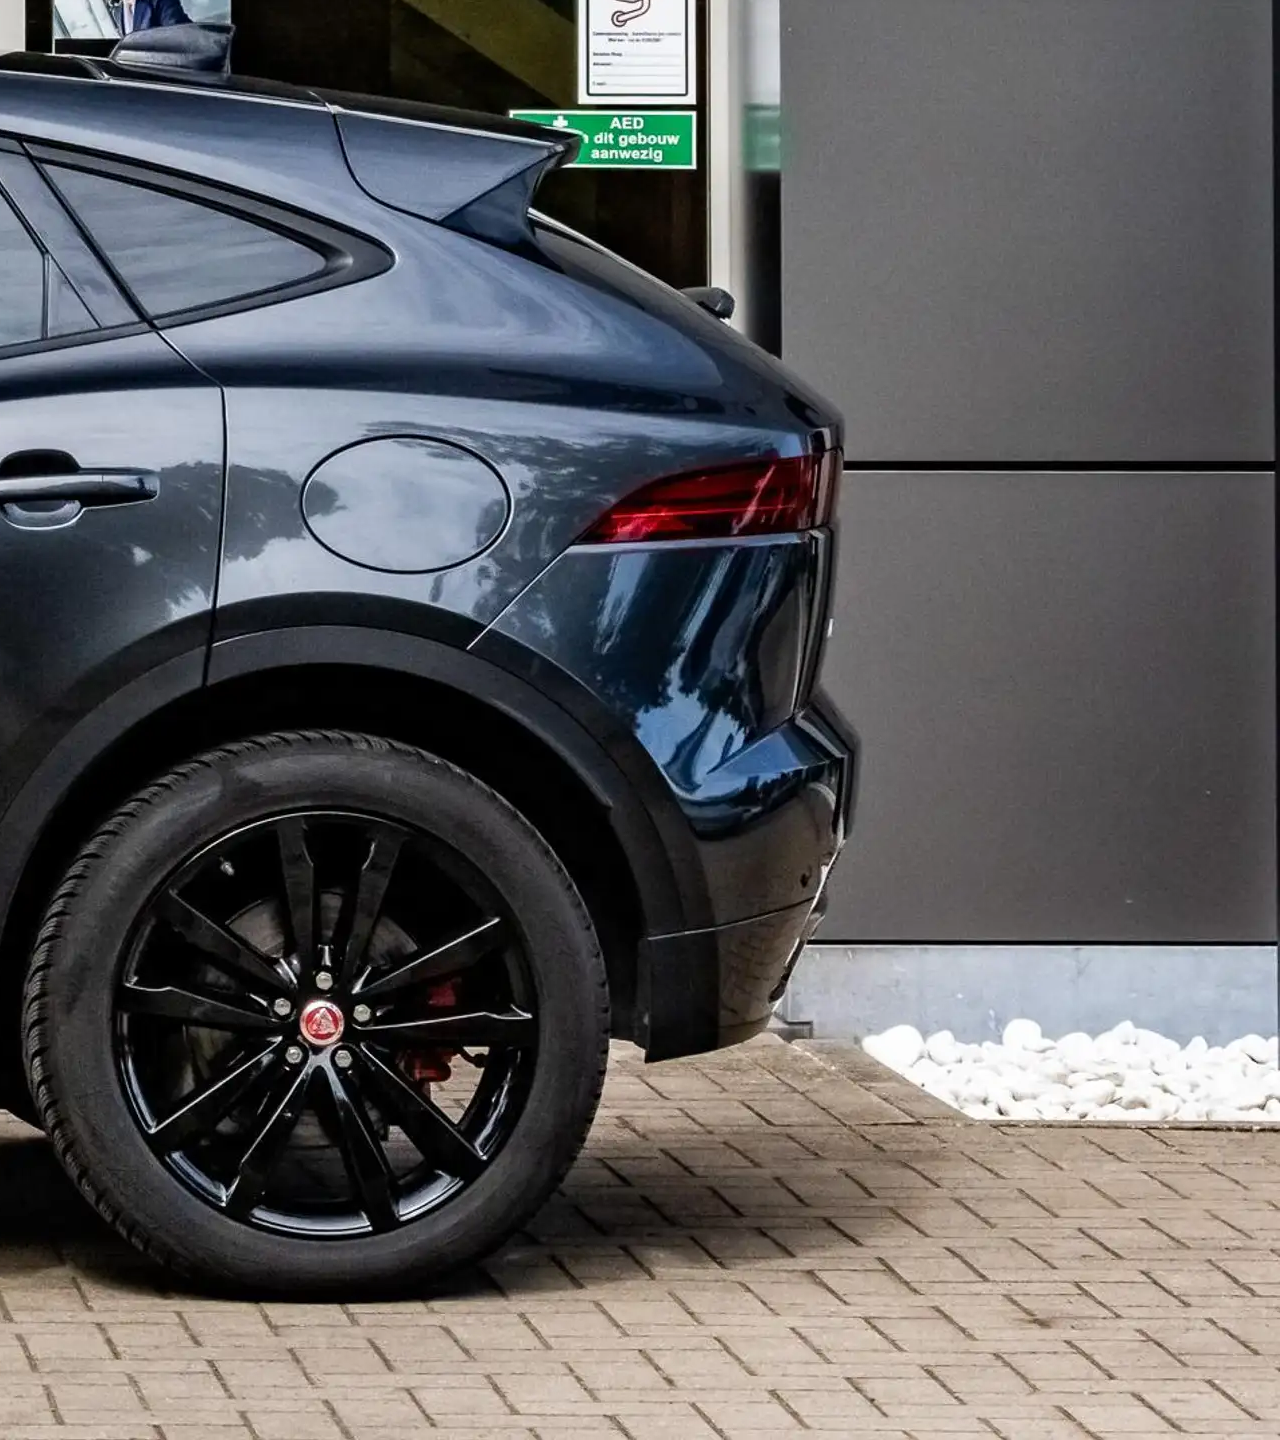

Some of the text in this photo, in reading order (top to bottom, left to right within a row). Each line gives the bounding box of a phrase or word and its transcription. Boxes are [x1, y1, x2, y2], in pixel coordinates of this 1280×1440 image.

[610, 116, 644, 130] AED
[594, 132, 614, 144] dit
[619, 132, 680, 147] gebouw
[591, 147, 663, 162] aanwezig
